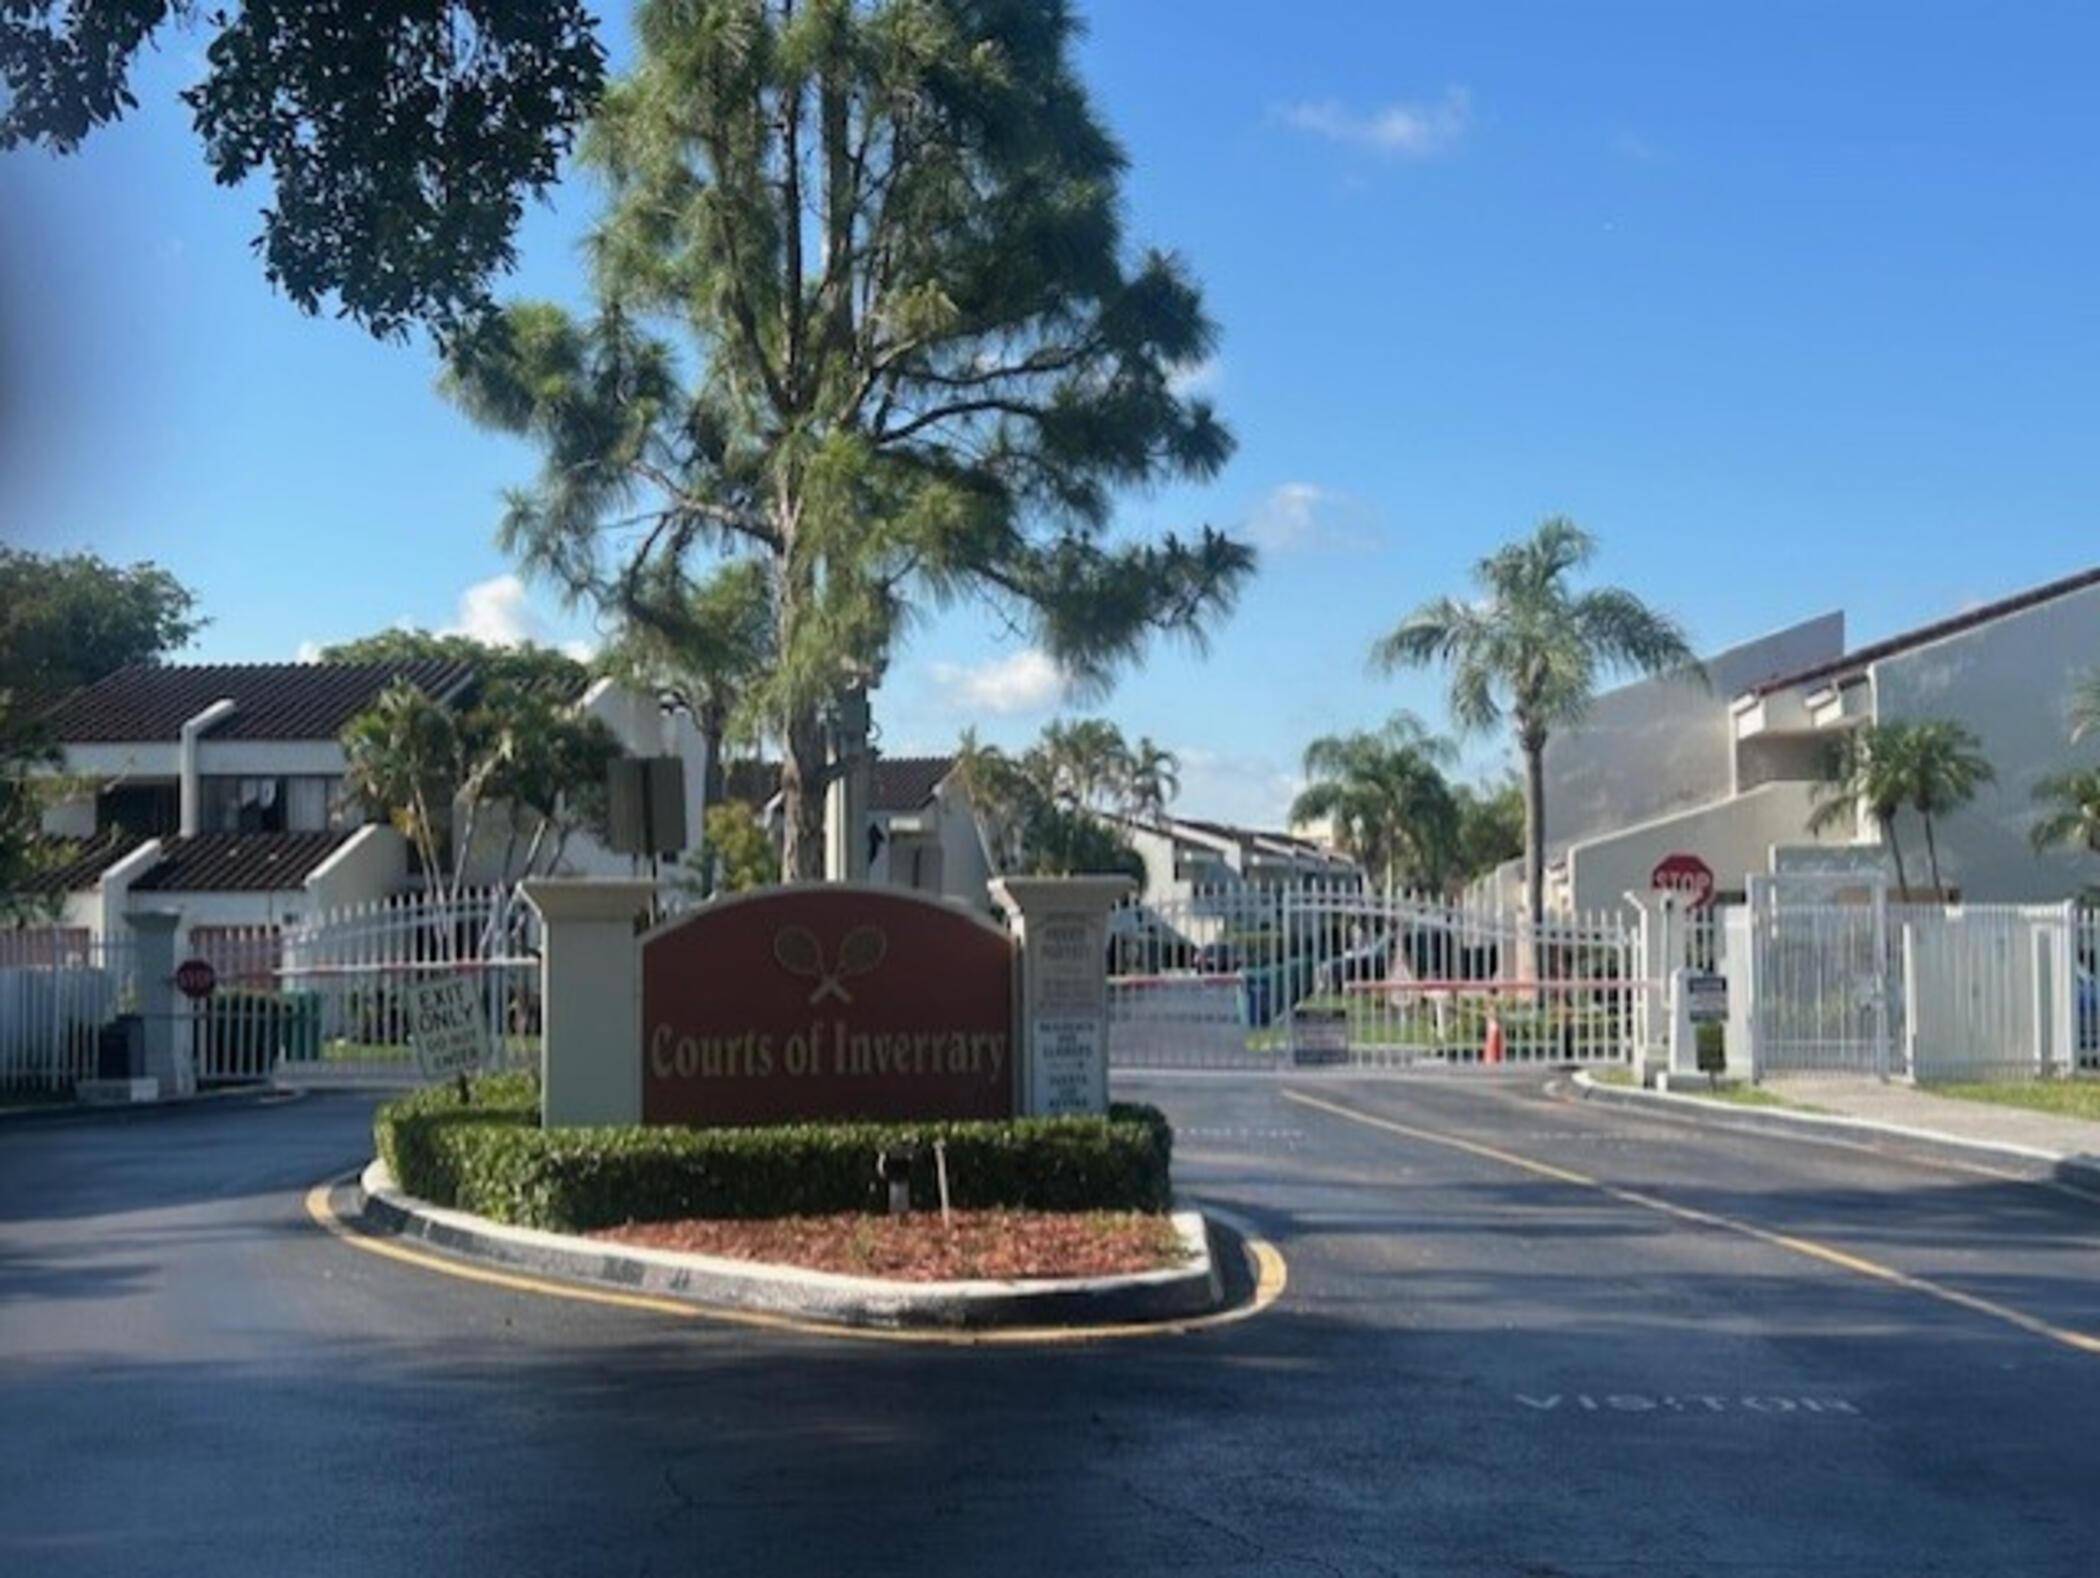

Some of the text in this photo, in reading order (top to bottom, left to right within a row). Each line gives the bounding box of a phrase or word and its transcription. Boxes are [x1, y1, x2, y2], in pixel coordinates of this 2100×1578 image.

[1656, 870, 1710, 895] STOP
[419, 981, 463, 1012] EXIT
[420, 1003, 473, 1033] ONLY
[650, 1020, 1006, 1082] Courts of Inverrary
